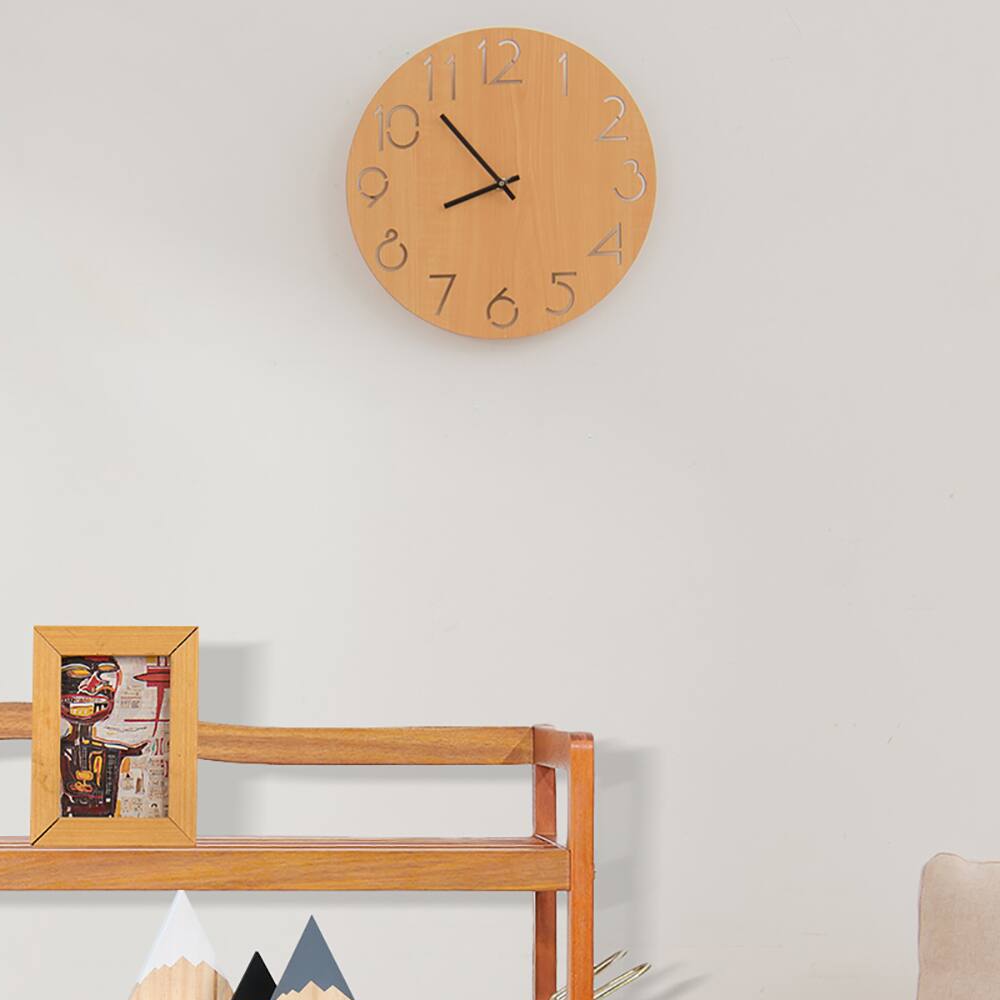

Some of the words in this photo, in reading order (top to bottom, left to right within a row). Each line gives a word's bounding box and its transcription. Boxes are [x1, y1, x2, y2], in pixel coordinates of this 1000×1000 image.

[423, 53, 457, 101] 11
[477, 38, 523, 85] 12
[557, 51, 569, 97] 1
[374, 103, 420, 151] 10
[597, 95, 629, 142] 2
[358, 166, 389, 208] 9
[614, 158, 647, 202] 3
[375, 228, 408, 272] 8
[586, 222, 623, 266] 4
[429, 273, 457, 316] 7
[486, 287, 519, 329] 6
[546, 271, 577, 316] 5
